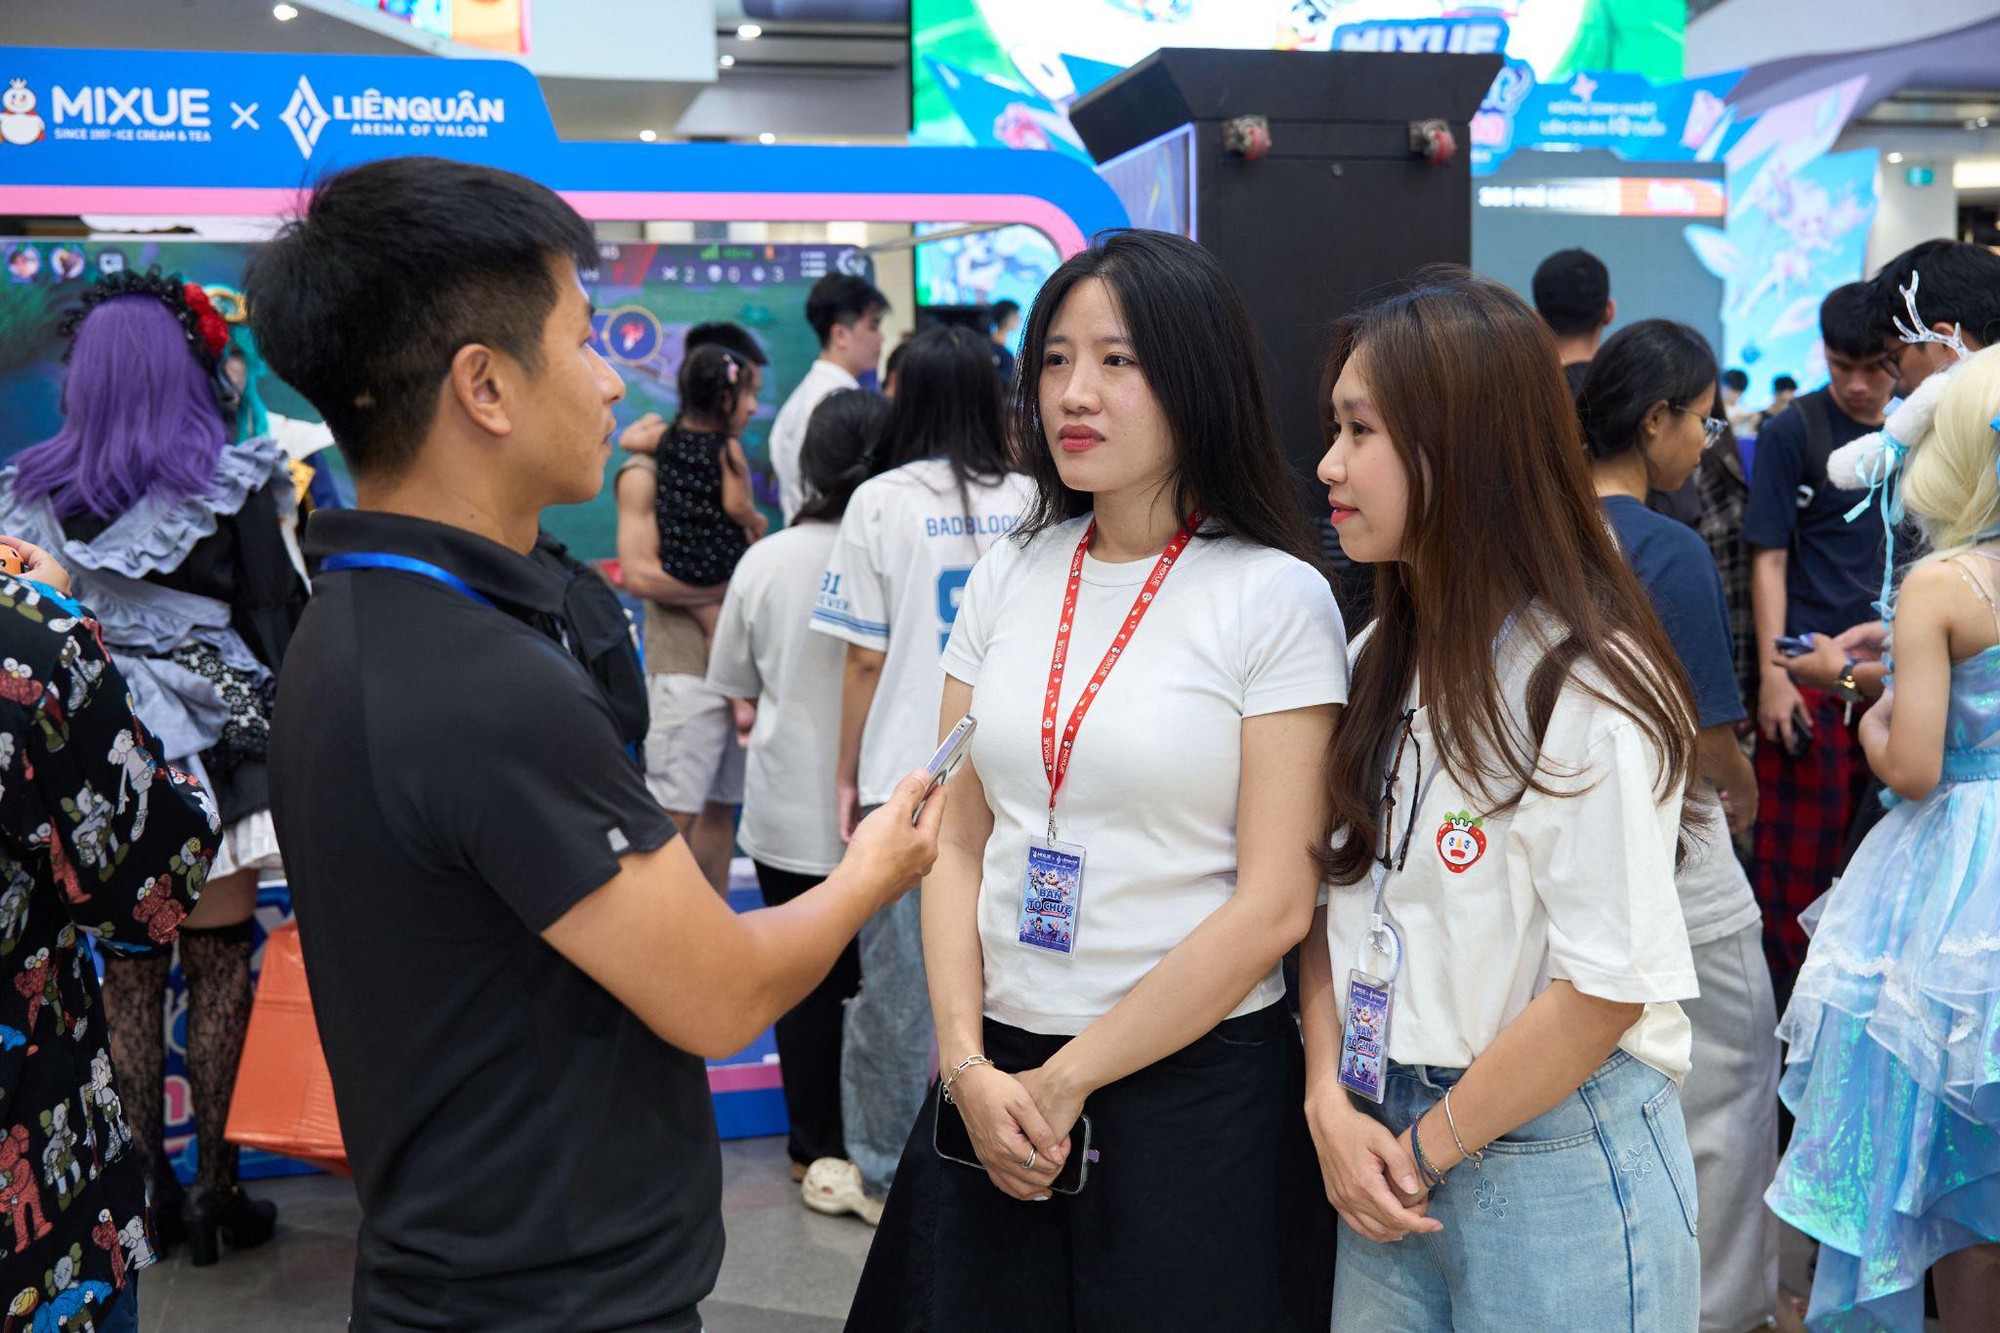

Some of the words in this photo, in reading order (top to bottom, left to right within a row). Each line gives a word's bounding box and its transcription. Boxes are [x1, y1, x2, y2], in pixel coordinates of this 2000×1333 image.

[52, 85, 211, 126] MIXUE
[54, 127, 88, 140] SINCE
[135, 129, 176, 142] CREAM
[177, 130, 187, 142] &
[188, 130, 212, 142] TEA
[351, 122, 405, 136] ARENA
[409, 122, 429, 136] OF
[434, 124, 488, 138] VALOR
[926, 515, 1019, 537] BADBLOO
[1152, 564, 1168, 586] MIXUE
[1055, 640, 1065, 662] MIXUE
[1100, 654, 1117, 677] MIXUE
[1039, 888, 1062, 900] BAN
